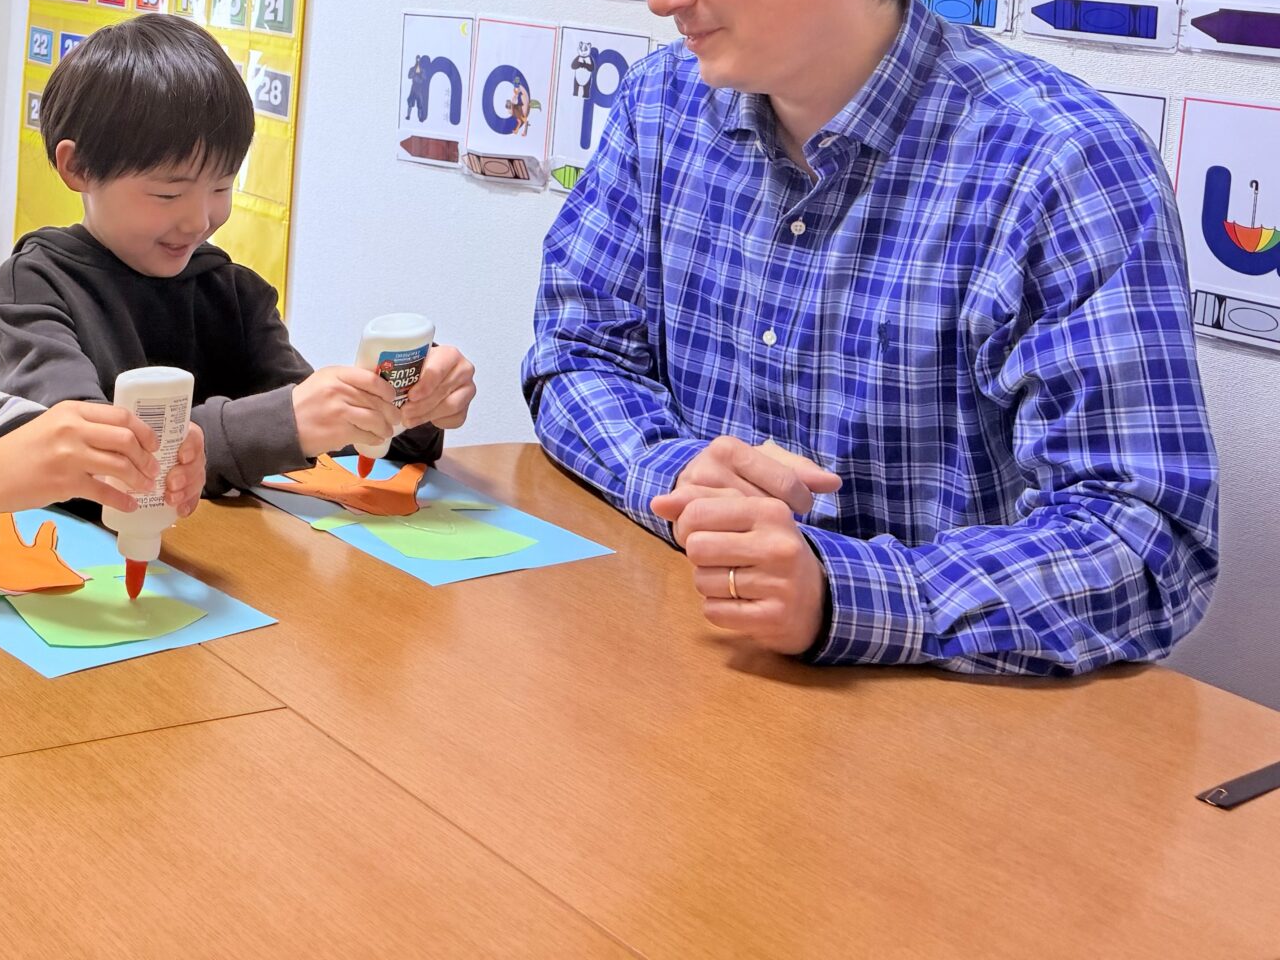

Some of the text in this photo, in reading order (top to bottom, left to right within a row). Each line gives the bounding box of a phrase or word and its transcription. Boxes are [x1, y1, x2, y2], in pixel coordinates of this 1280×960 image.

[33, 33, 48, 56] 22
[258, 76, 282, 106] 28
[420, 54, 463, 126] n
[482, 64, 532, 136] o
[579, 46, 630, 150] p
[390, 367, 417, 380] GLUE
